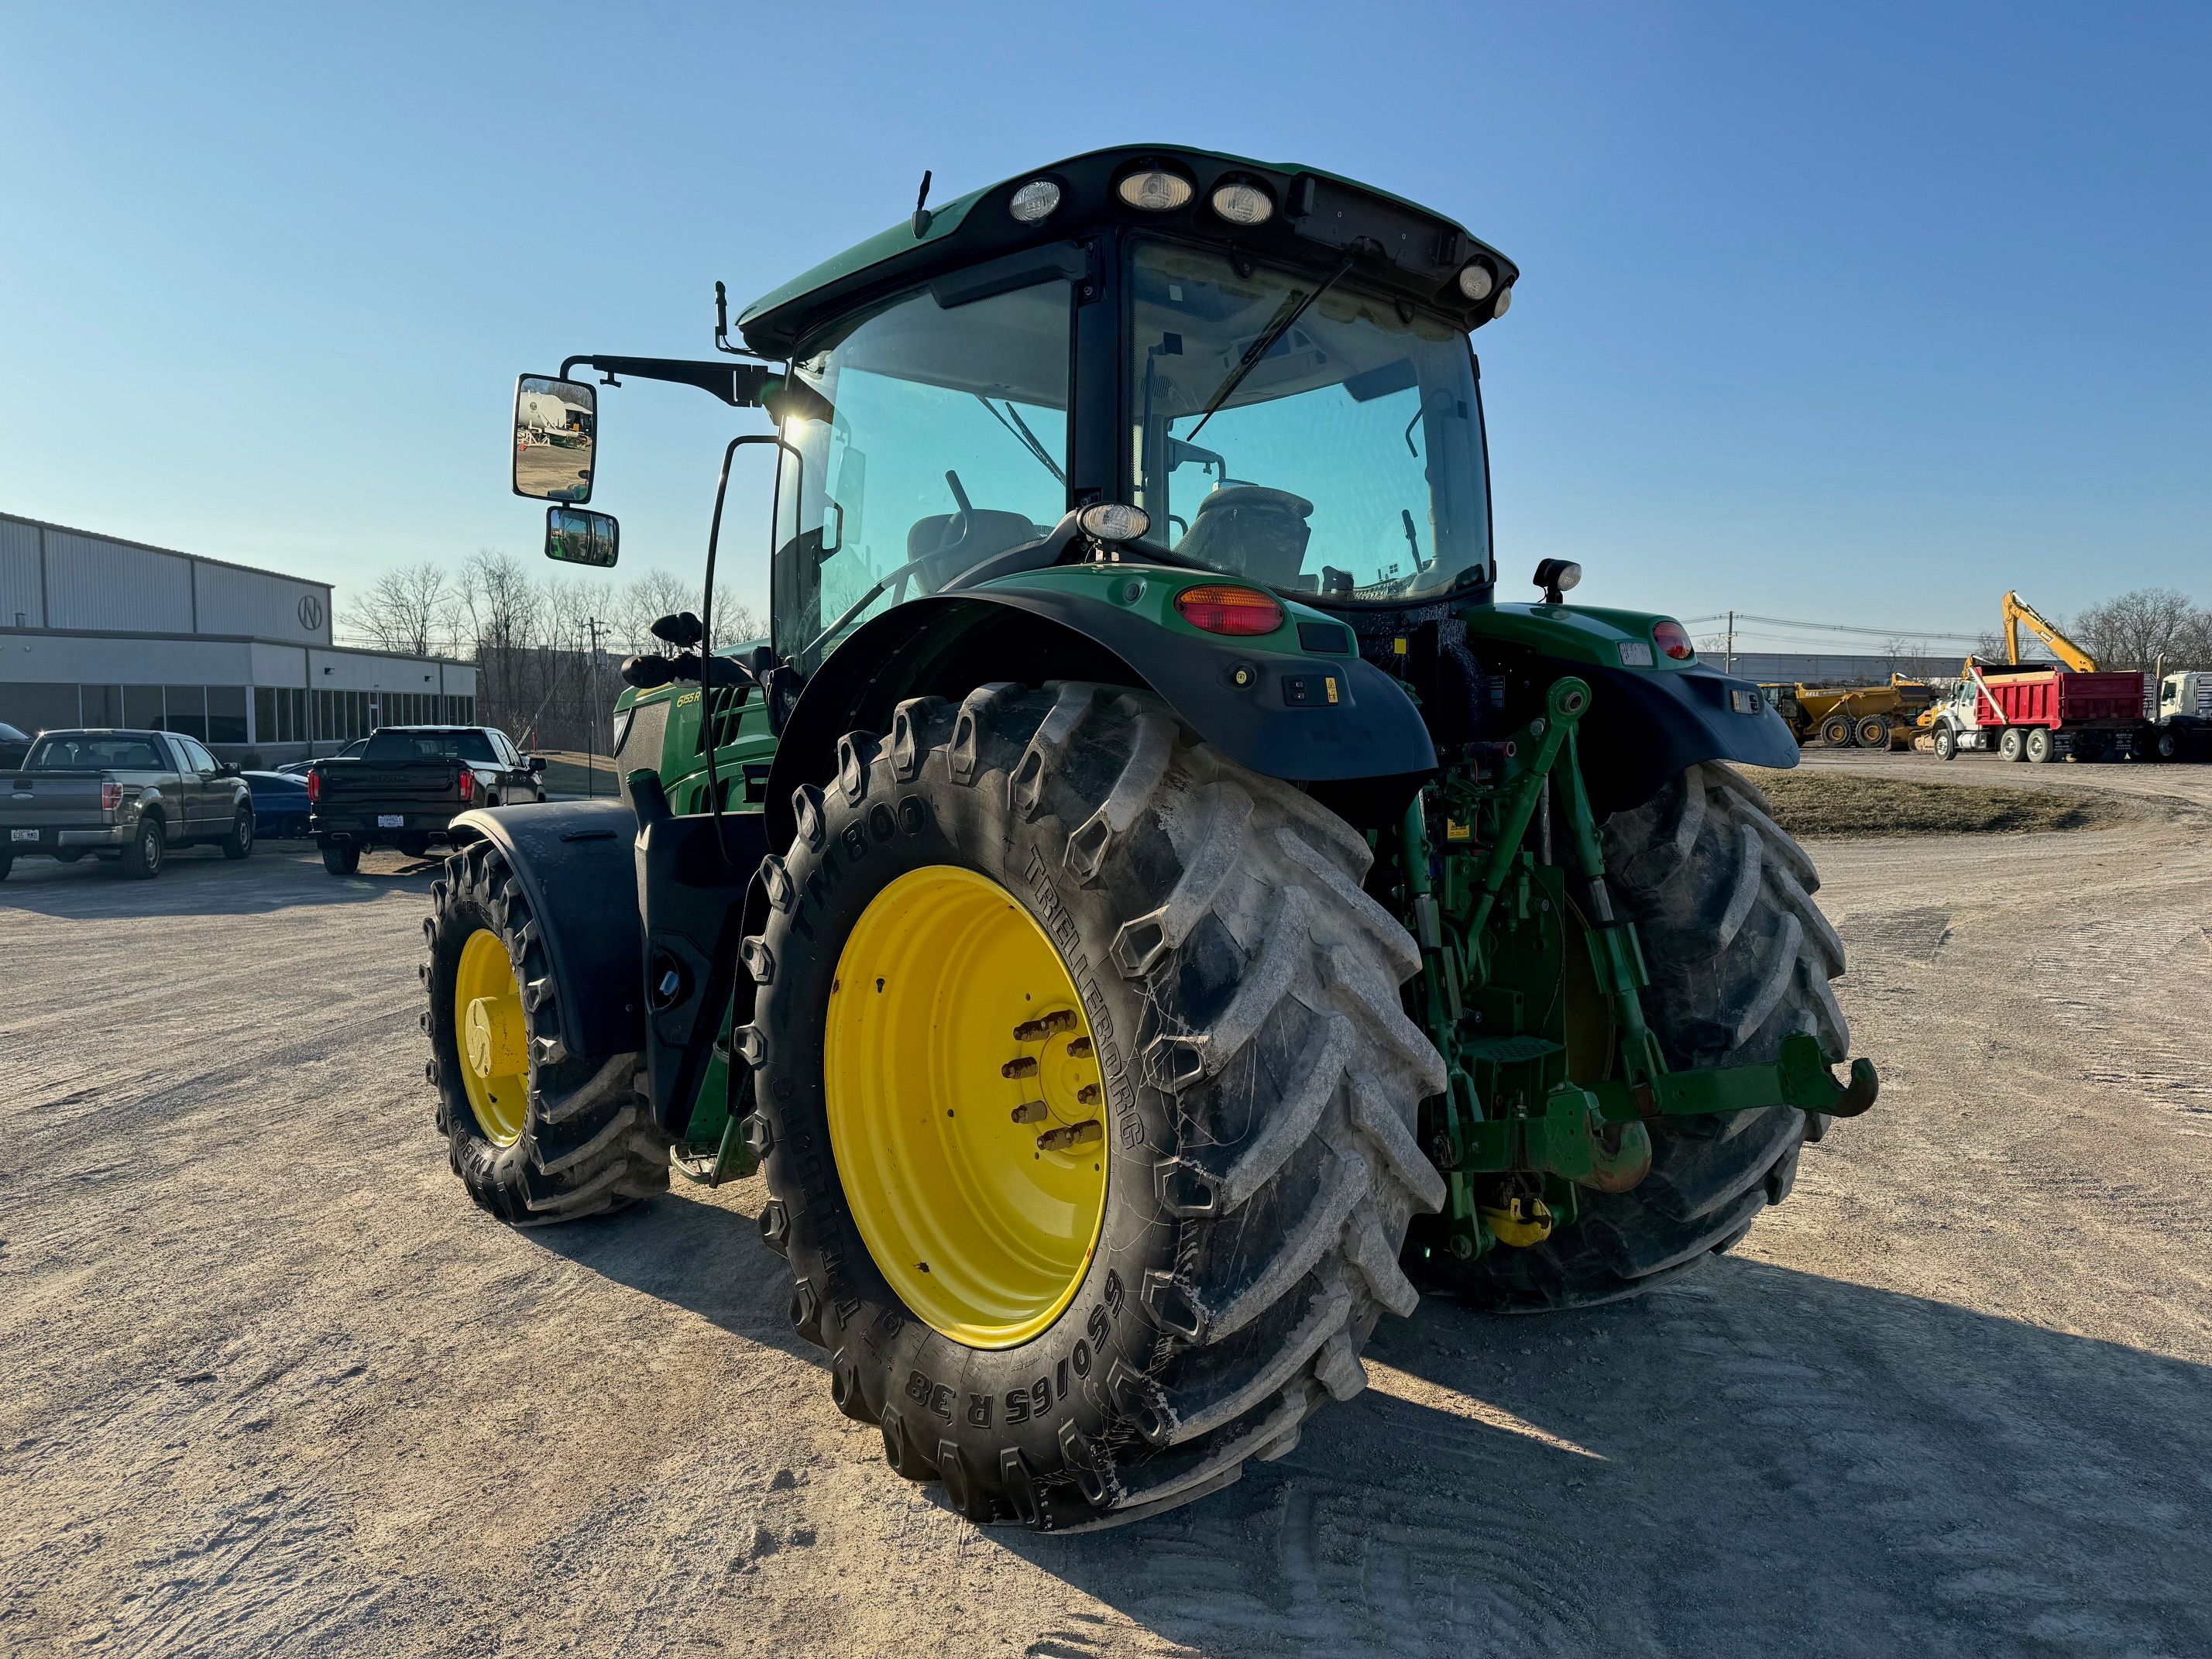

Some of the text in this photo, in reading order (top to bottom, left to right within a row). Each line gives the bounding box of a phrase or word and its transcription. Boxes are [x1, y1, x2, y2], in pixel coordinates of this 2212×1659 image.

[1023, 843, 1145, 1150] TRELLEBORG
[905, 1268, 1125, 1429] 650/65 R 38
